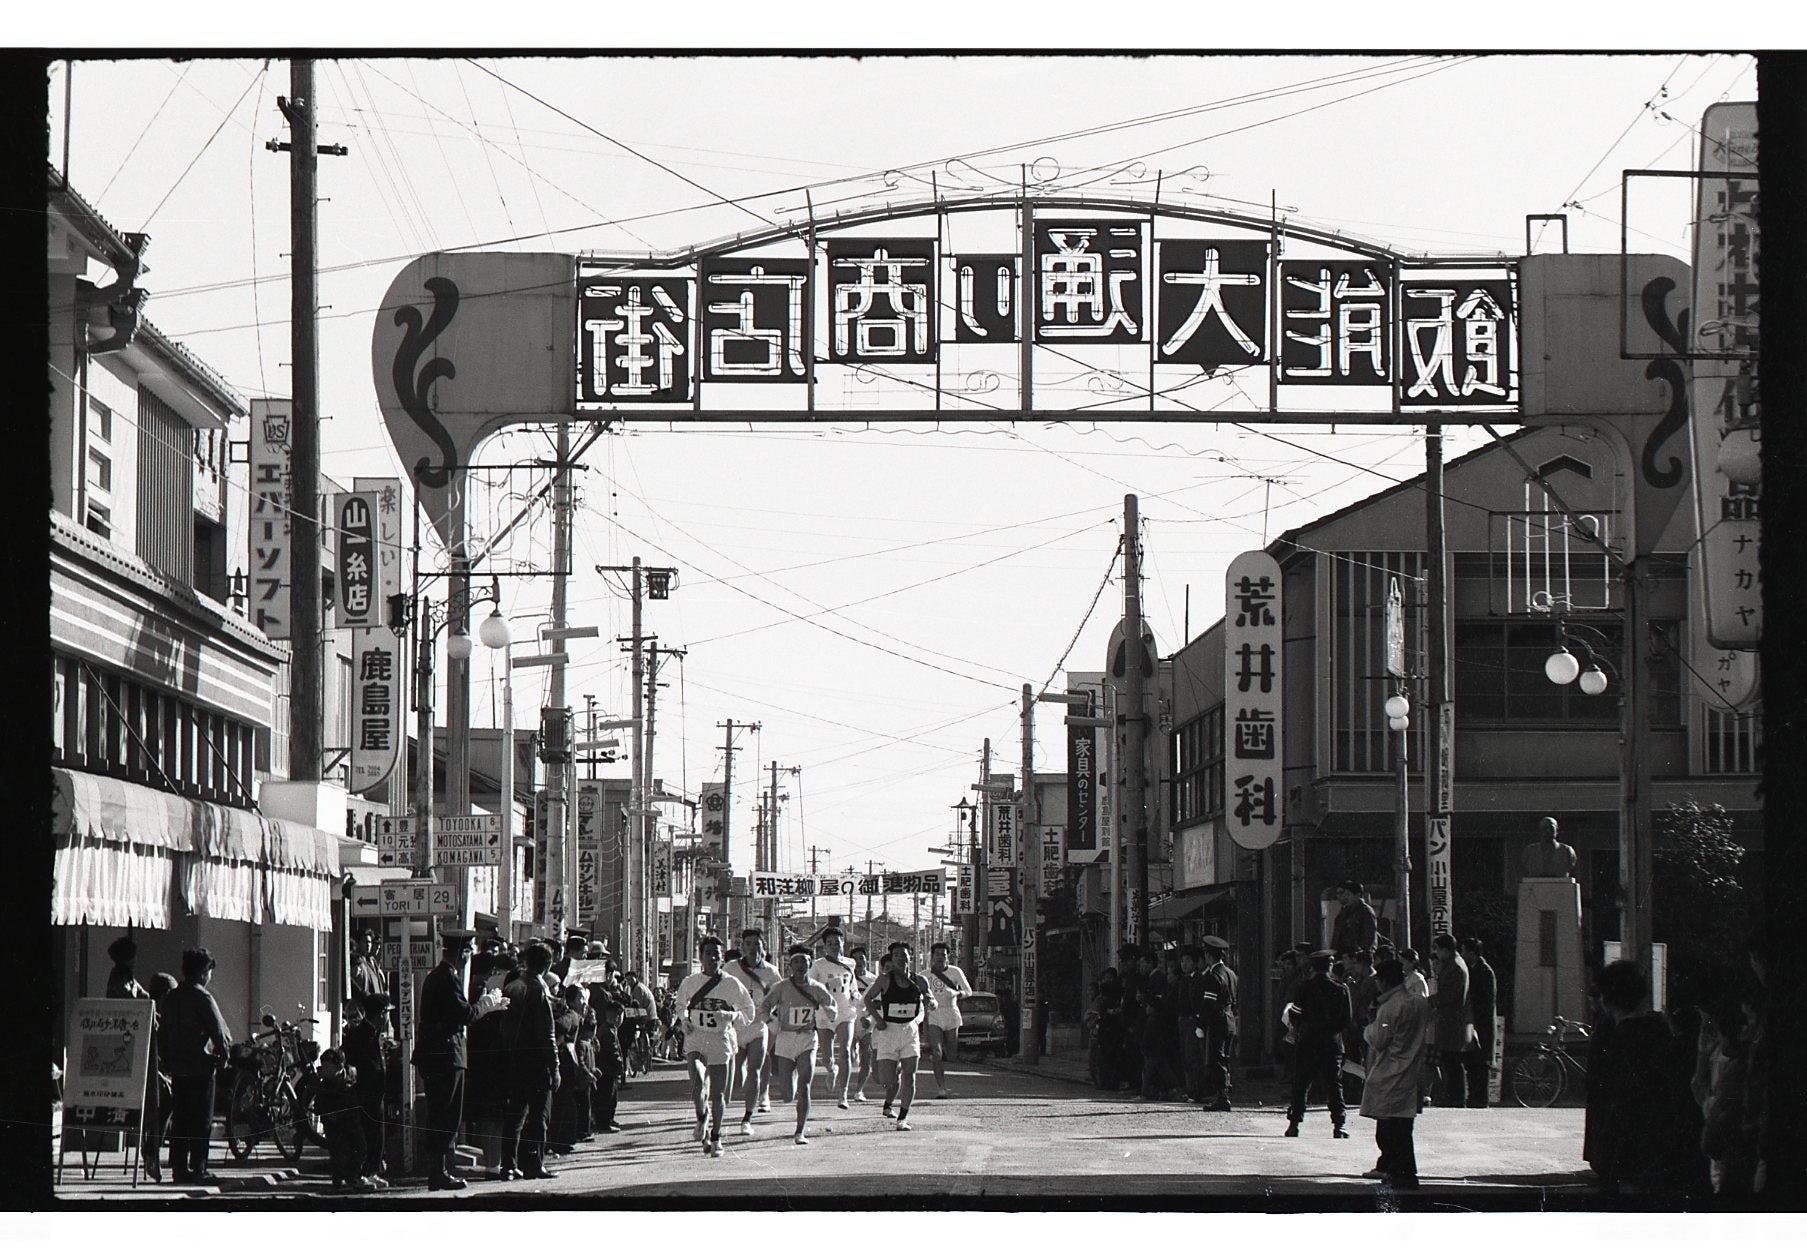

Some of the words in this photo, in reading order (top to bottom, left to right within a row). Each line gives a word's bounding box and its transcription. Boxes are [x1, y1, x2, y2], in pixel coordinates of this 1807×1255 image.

[255, 464, 282, 631] エバーソフト
[346, 501, 368, 611] 山一糸店
[1733, 533, 1755, 626] ナカヤ
[360, 646, 392, 751] 鹿島屋
[1234, 576, 1277, 826] 荒井歯科
[382, 836, 393, 845] 10
[437, 834, 484, 848] MOTOSAYAMA
[439, 818, 481, 832] TOYOOKA
[998, 806, 1012, 862] 荒井歯科
[437, 850, 483, 864] KOMAGAWA
[1043, 827, 1060, 894] 土肥歯科
[434, 890, 450, 904] 29
[959, 866, 972, 910] 土肥歯科
[387, 943, 430, 955] PEDTRIAN
[794, 1009, 811, 1025] 12
